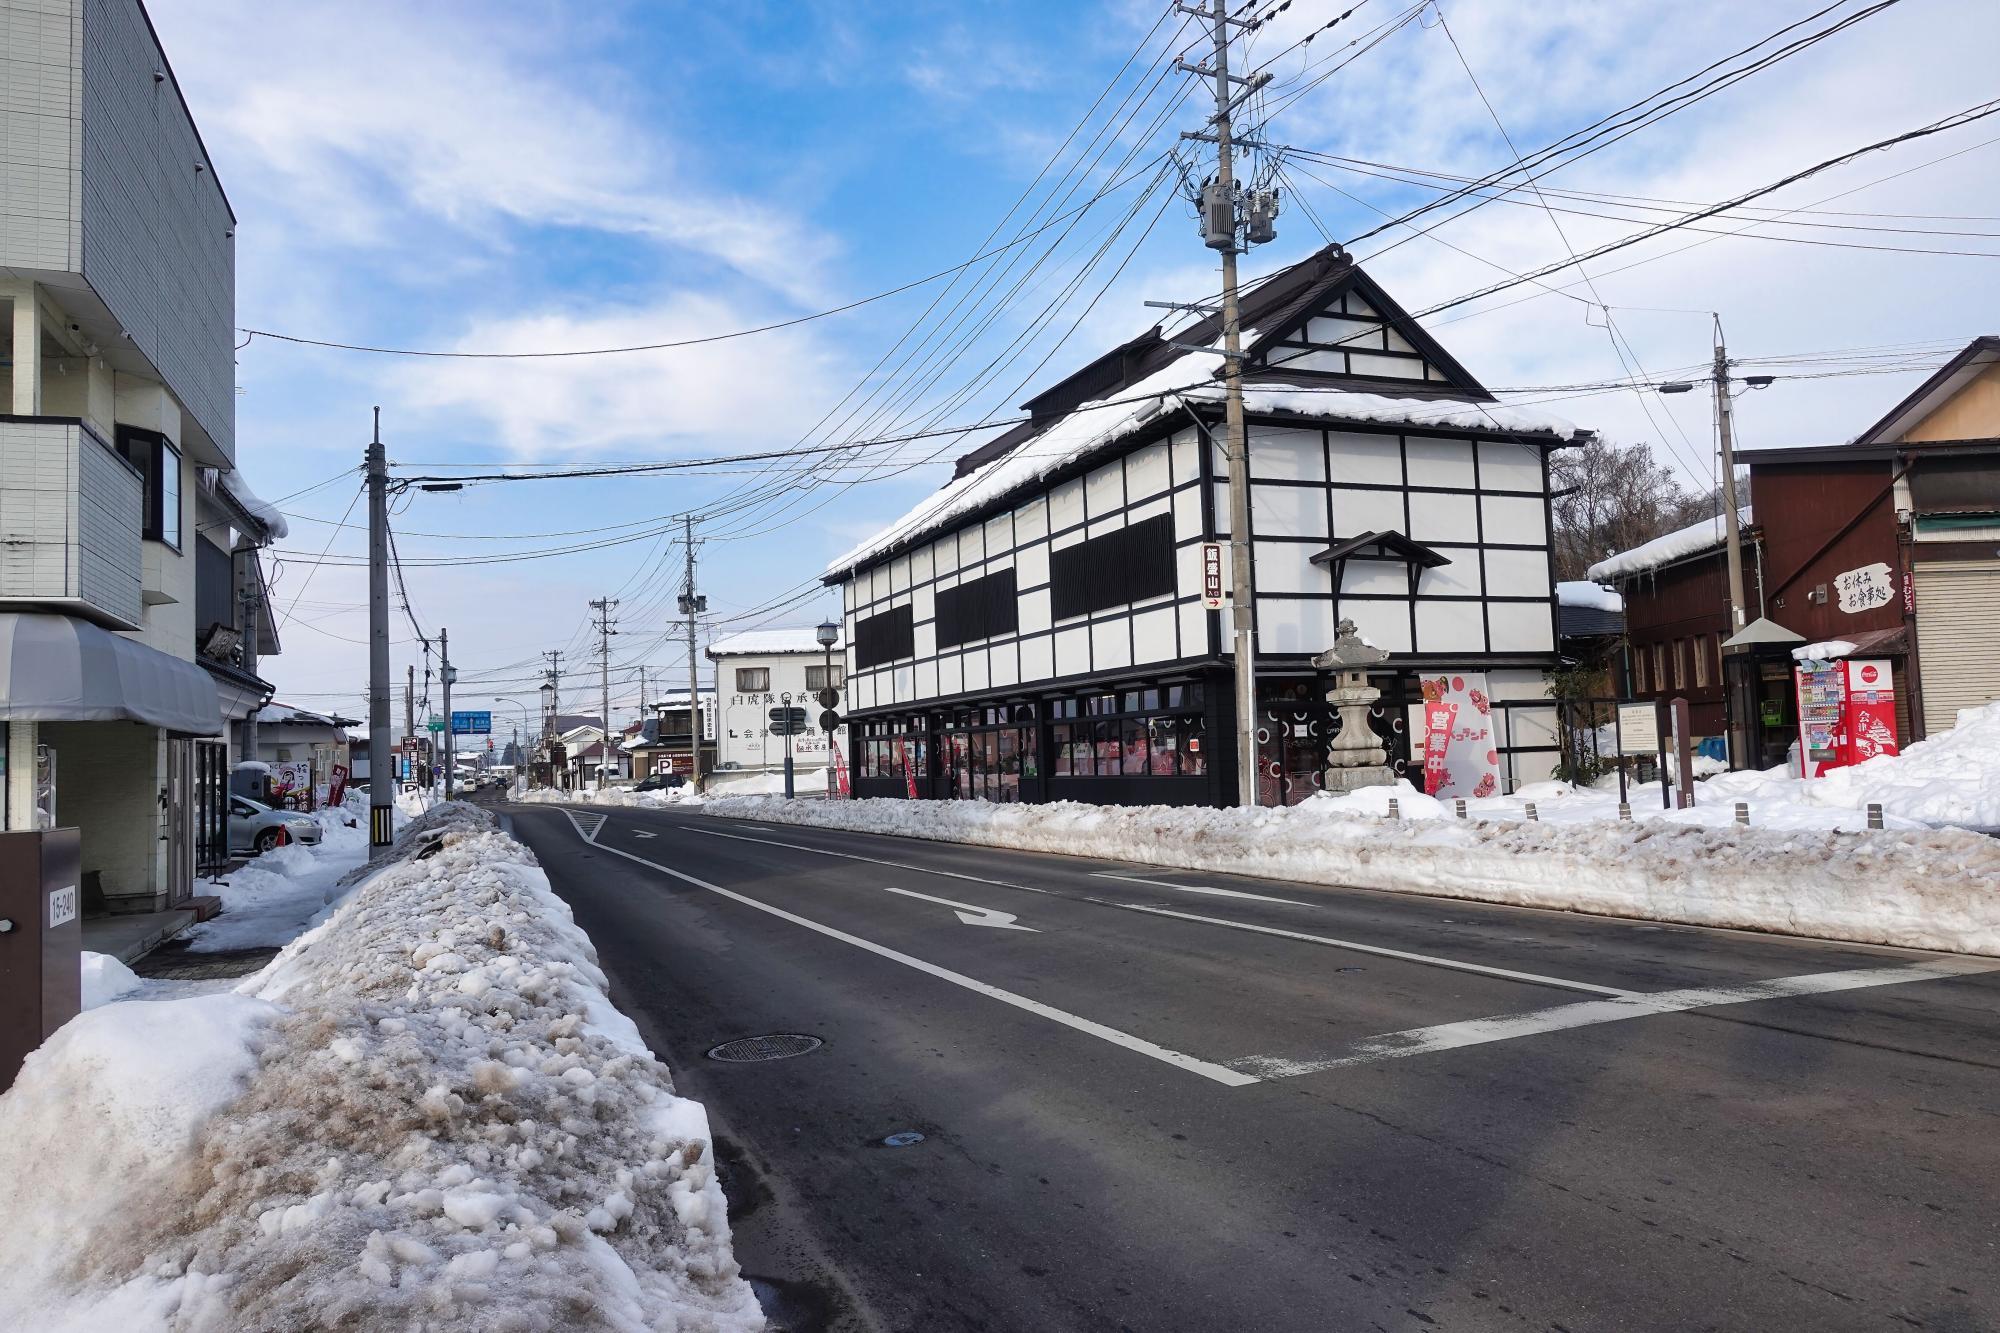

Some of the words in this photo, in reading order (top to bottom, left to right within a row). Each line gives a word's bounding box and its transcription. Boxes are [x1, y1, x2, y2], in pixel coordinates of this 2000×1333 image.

[1206, 547, 1219, 589] 飯盛山
[1843, 571, 1872, 591] お休み
[1848, 584, 1888, 608] お食事処
[1427, 711, 1450, 774] 営業中
[659, 760, 671, 774] P
[52, 891, 74, 921] 15-240
